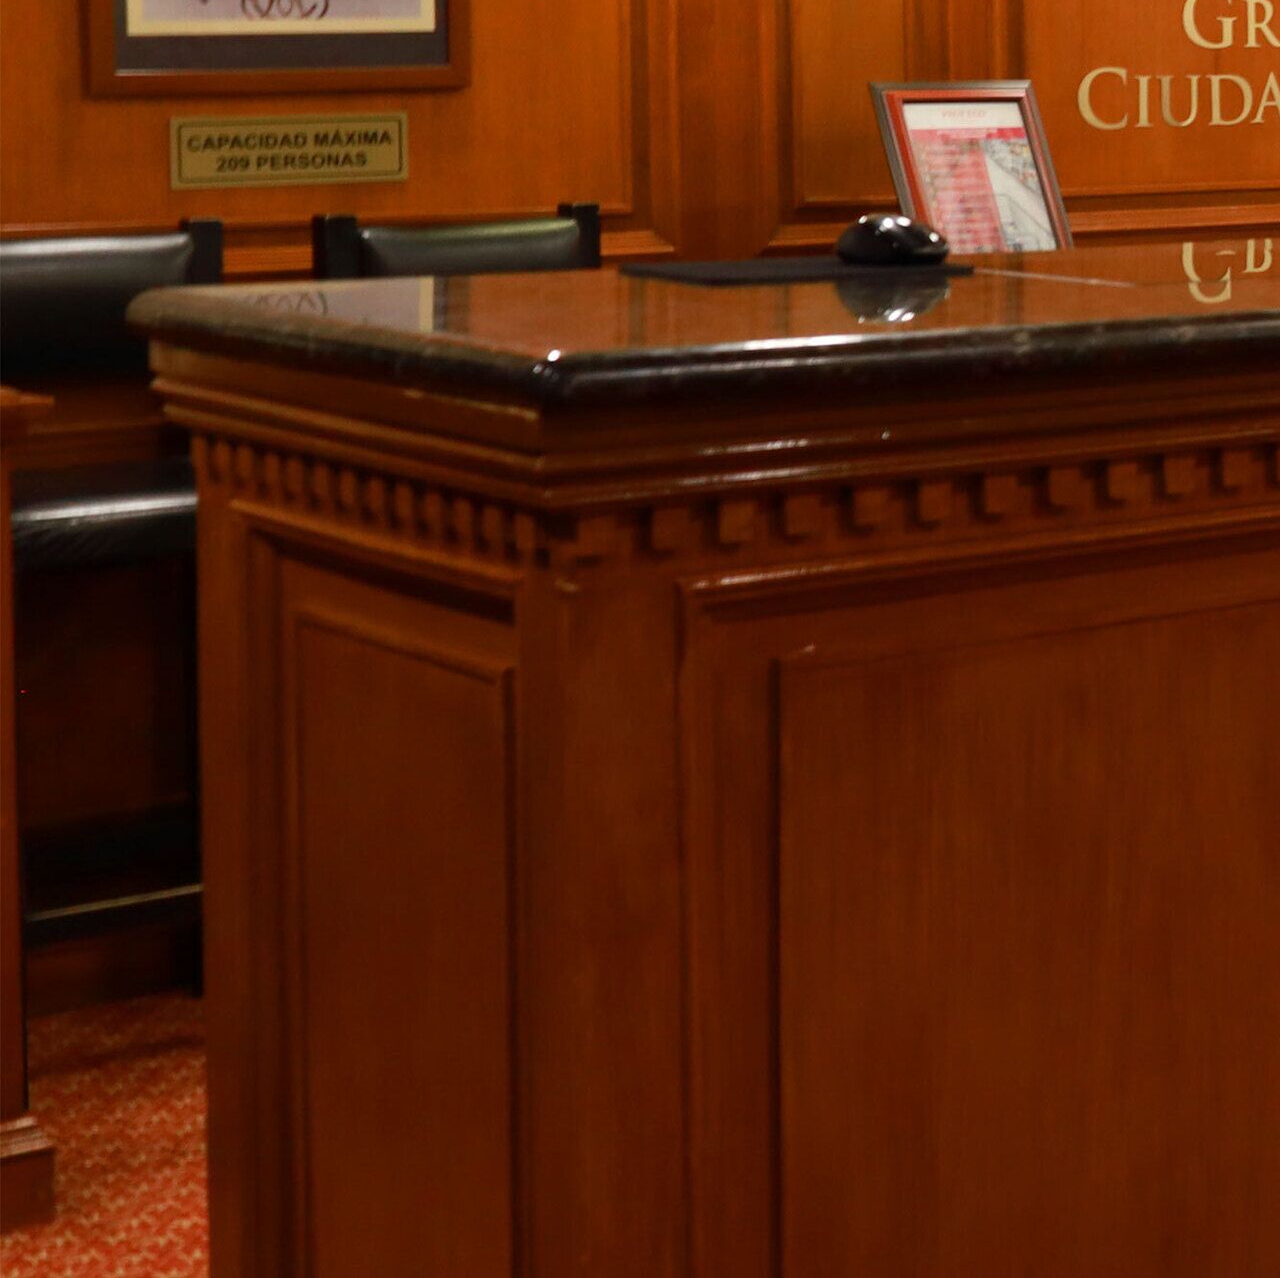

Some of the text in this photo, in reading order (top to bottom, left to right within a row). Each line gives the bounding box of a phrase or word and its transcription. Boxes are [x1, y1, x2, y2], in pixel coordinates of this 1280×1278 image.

[186, 128, 394, 153] CAPACIDAD MÁXIMA
[255, 150, 369, 171] PERSONAS
